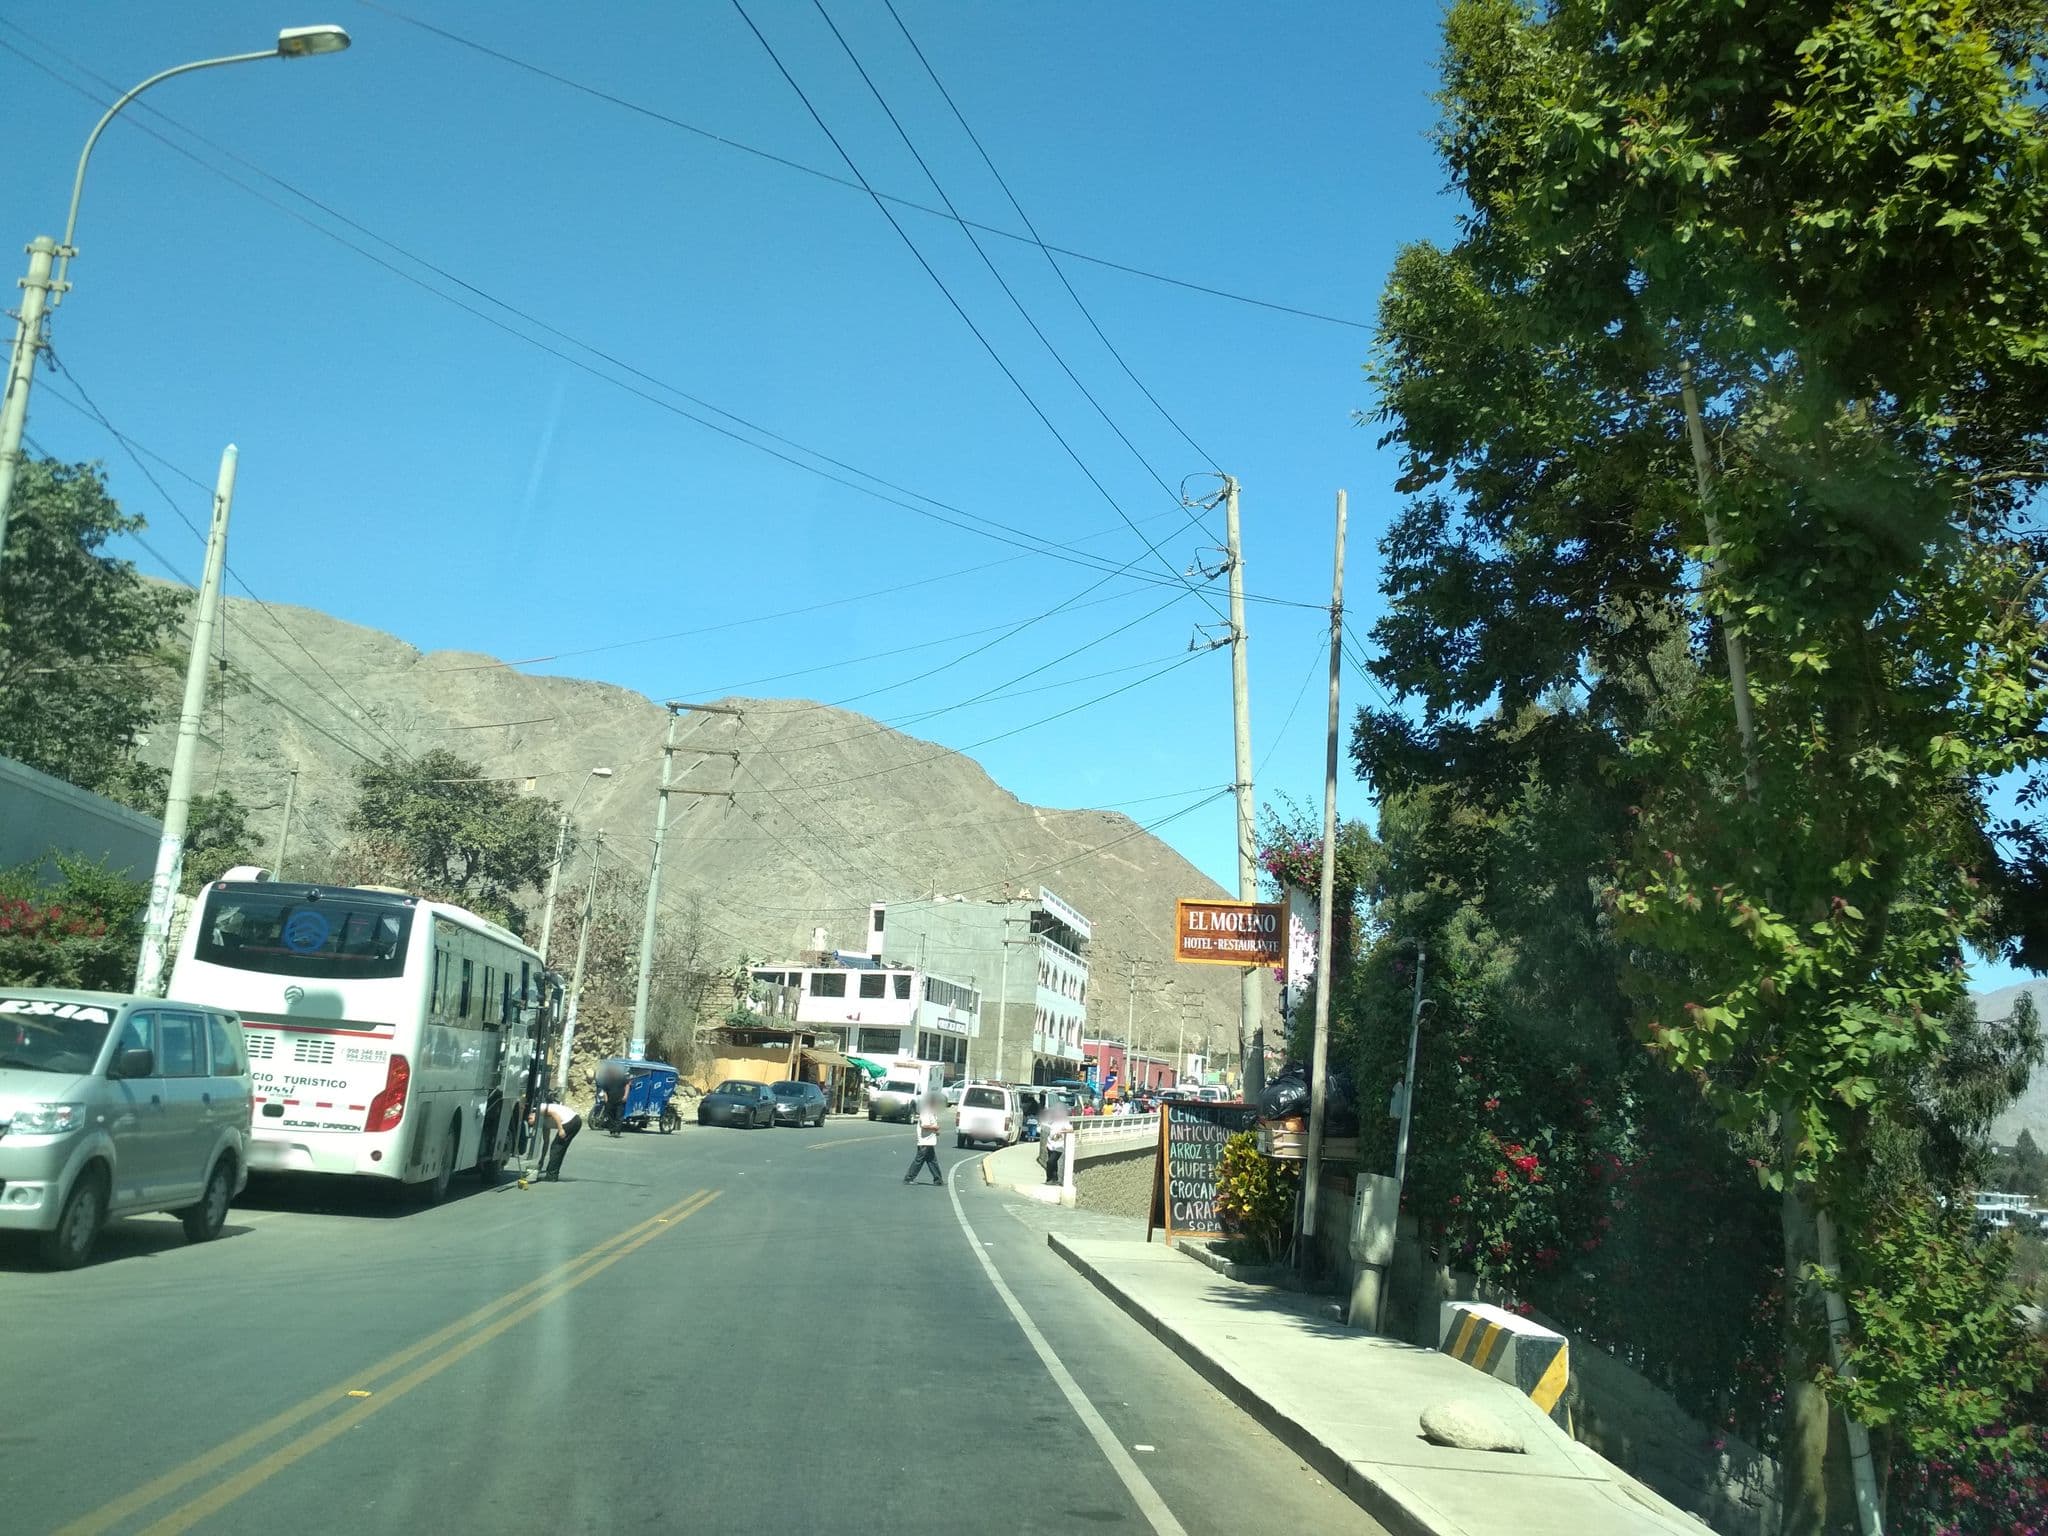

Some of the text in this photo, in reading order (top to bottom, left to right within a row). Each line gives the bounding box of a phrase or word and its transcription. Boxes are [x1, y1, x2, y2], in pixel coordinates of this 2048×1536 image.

[1189, 911, 1276, 933] EL MOLINO
[1183, 937, 1280, 953] HOTEL RESTAURANTE
[251, 1072, 274, 1082] CIO
[1170, 1125, 1233, 1142] ANTICUCHO
[1170, 1142, 1202, 1159] ARROZ
[1169, 1161, 1206, 1179] CHUPE
[1169, 1180, 1217, 1200] CROCAN
[1174, 1201, 1219, 1220] CARAP
